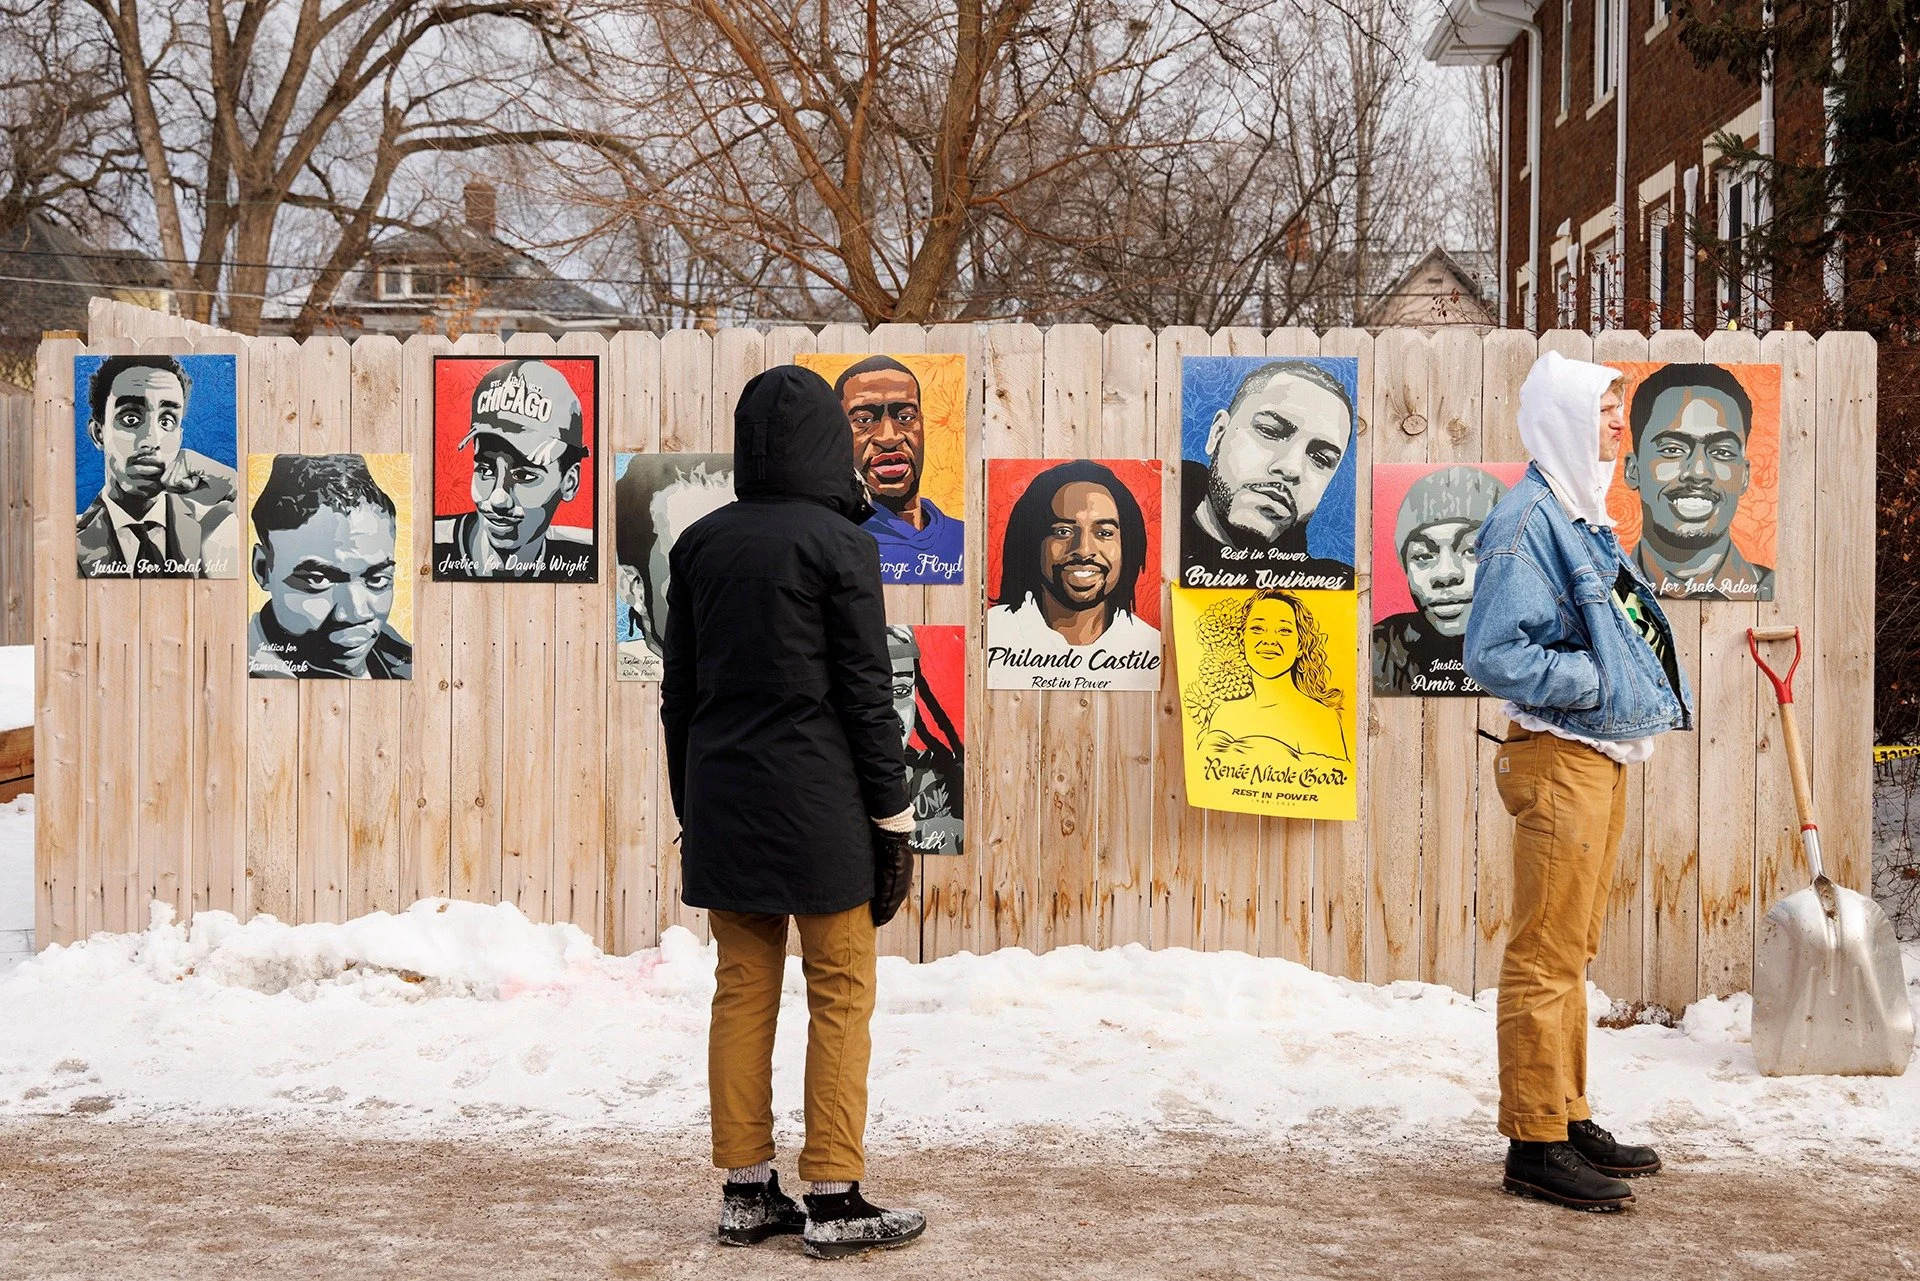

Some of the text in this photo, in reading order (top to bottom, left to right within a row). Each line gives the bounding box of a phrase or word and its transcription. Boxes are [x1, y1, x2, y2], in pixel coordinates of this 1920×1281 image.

[477, 379, 553, 423] CHICAGO
[1220, 546, 1309, 562] Rest in Power
[90, 558, 134, 577] Justice
[137, 558, 161, 574] For
[163, 558, 202, 574] Dolal
[438, 553, 590, 576] Justice for Daunte Wright
[880, 553, 964, 579] eorge Floyd
[1185, 564, 1347, 590] Brian Quiñones
[1659, 576, 1681, 596] for
[1684, 577, 1716, 594] Isak
[1718, 577, 1759, 594] Aden
[258, 641, 298, 653] Justice for
[248, 659, 309, 674] Jamar Clark
[987, 646, 1162, 671] Philando Castile
[1031, 675, 1112, 690] Rest in Power
[1411, 674, 1457, 692] Amir
[1250, 763, 1297, 786] Nicole
[1231, 787, 1319, 803] REST IN POWER
